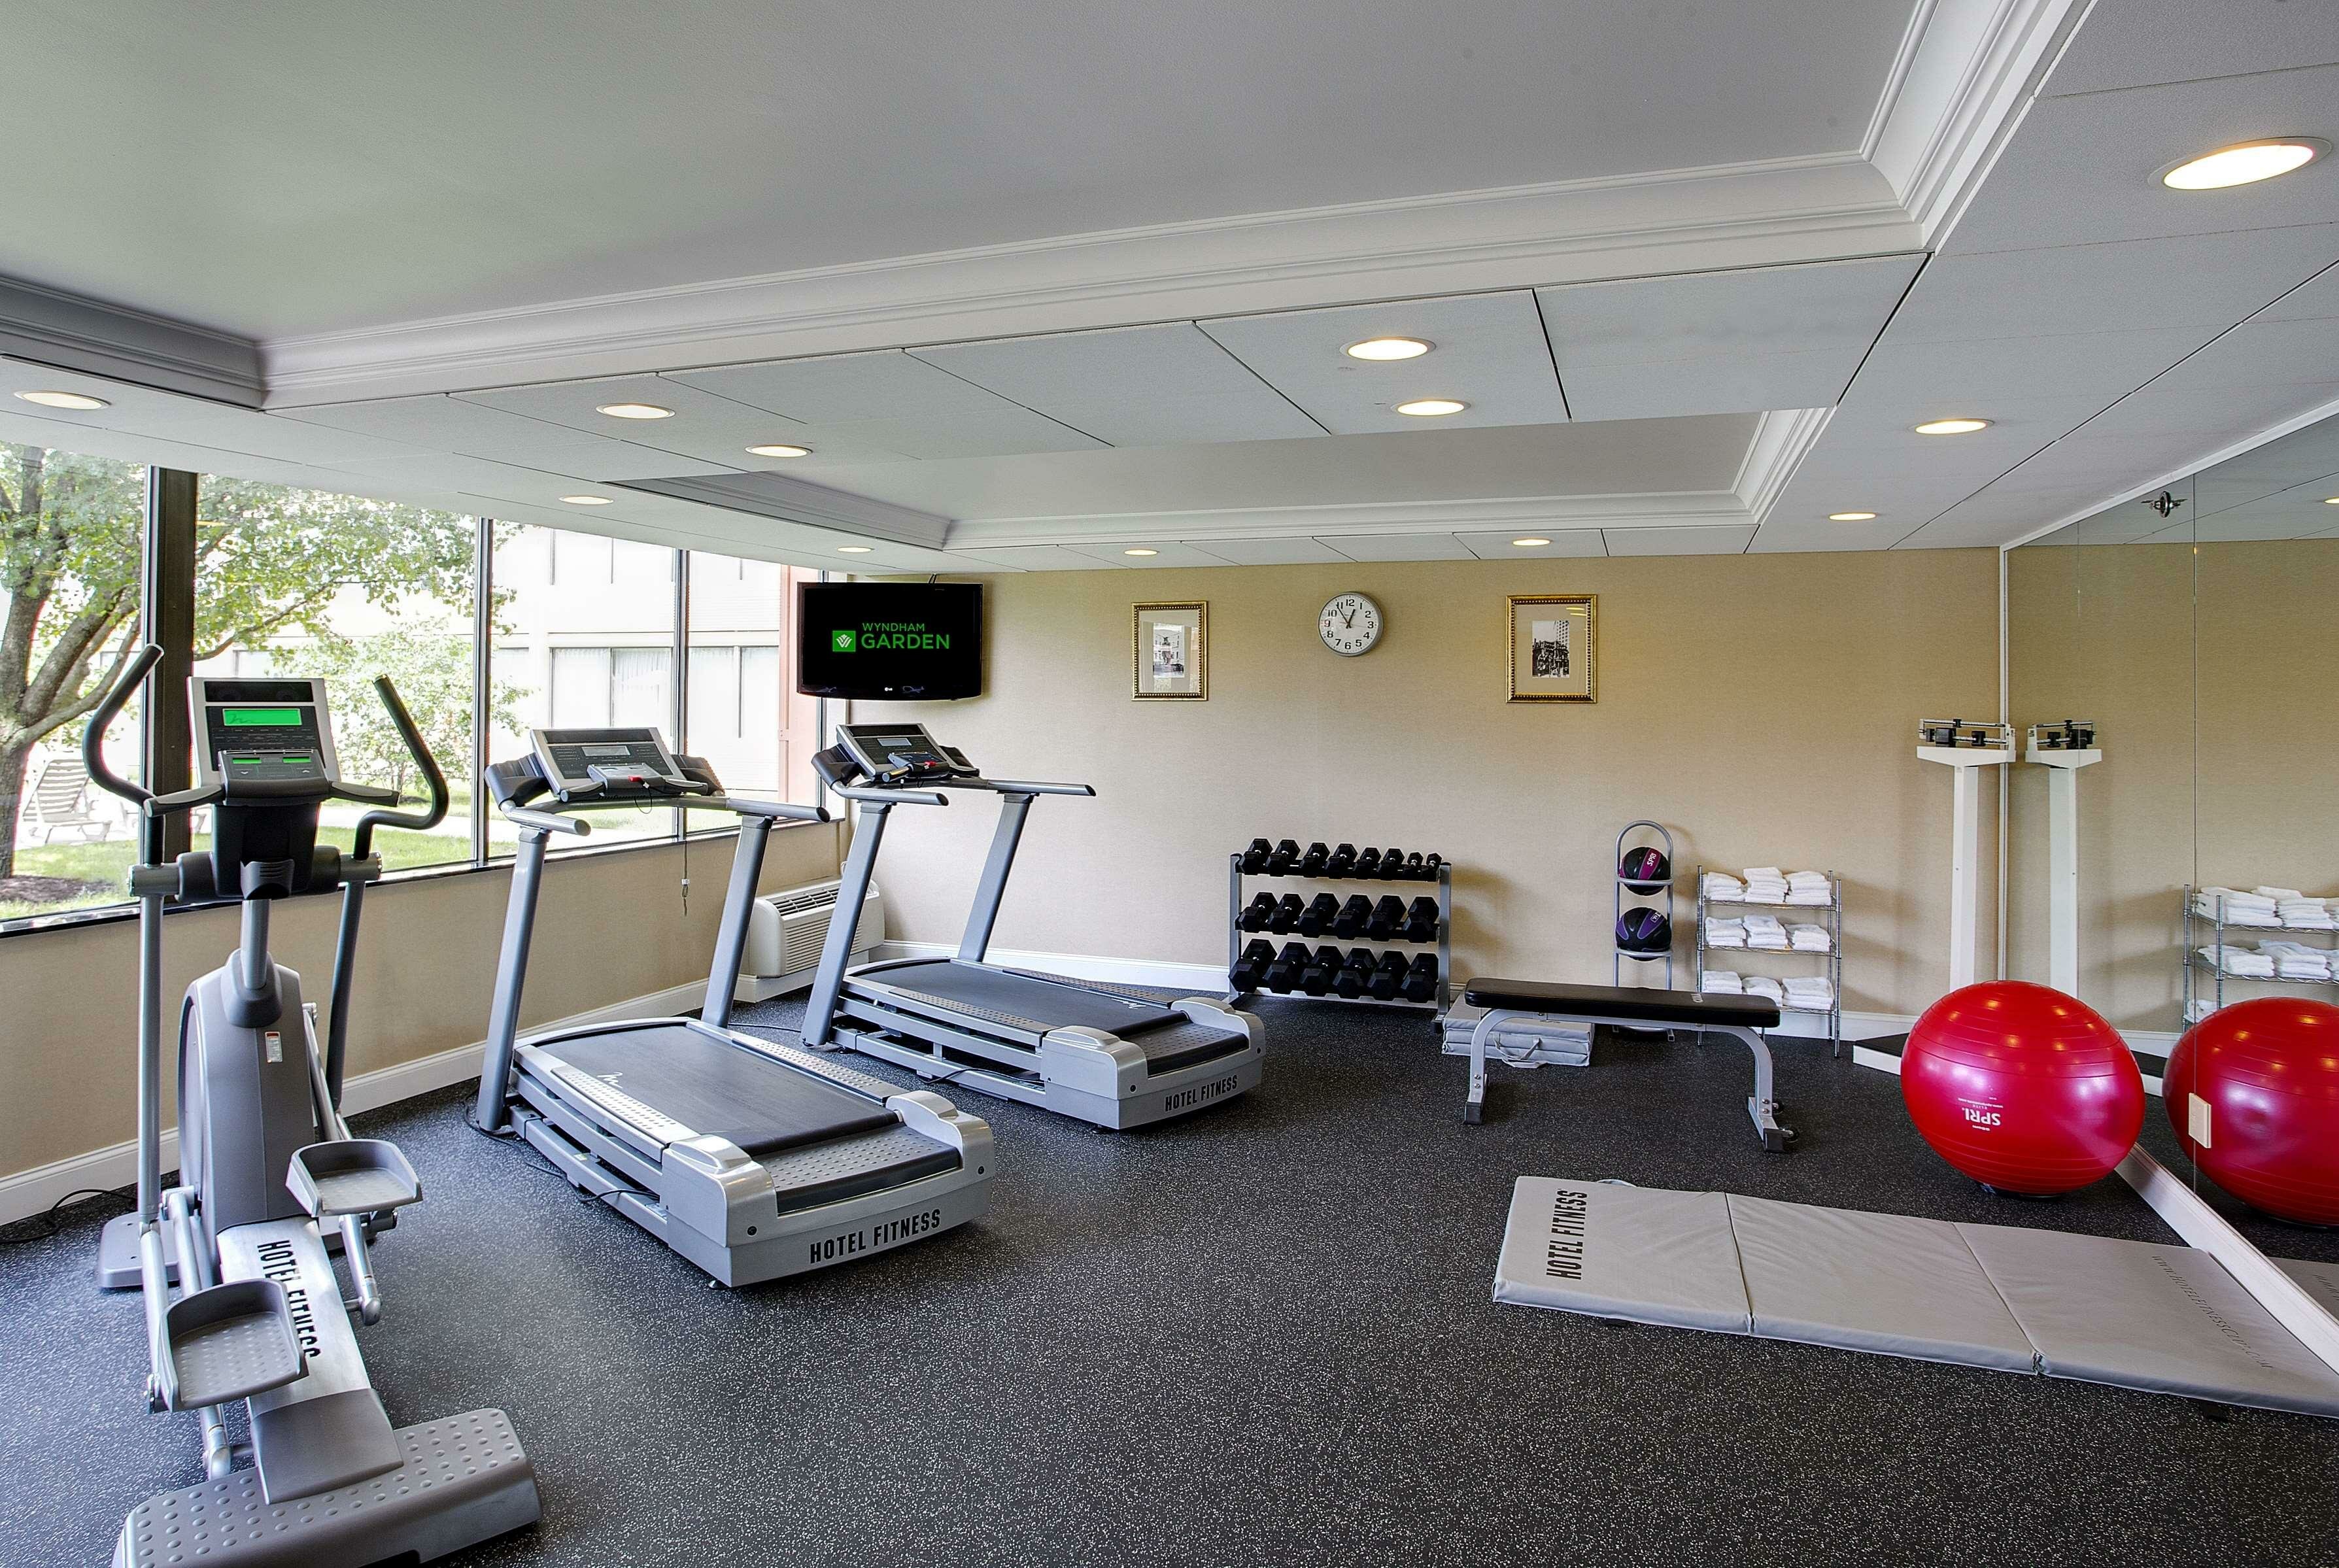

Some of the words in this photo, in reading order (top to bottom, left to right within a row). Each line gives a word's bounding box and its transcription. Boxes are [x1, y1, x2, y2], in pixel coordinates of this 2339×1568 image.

[862, 622, 925, 632] WYNDHAM
[861, 634, 949, 649] GARDEN
[1647, 852, 1657, 866] SPRI
[1165, 1089, 1198, 1112] HOTEL
[1201, 1074, 1237, 1100] FITNESS
[1964, 1108, 2001, 1125] SPRI
[1551, 1190, 1587, 1236] FITNESS
[810, 1231, 866, 1264] HOTEL
[874, 1209, 940, 1247] FITNESS
[1546, 1240, 1583, 1280] HOTEL
